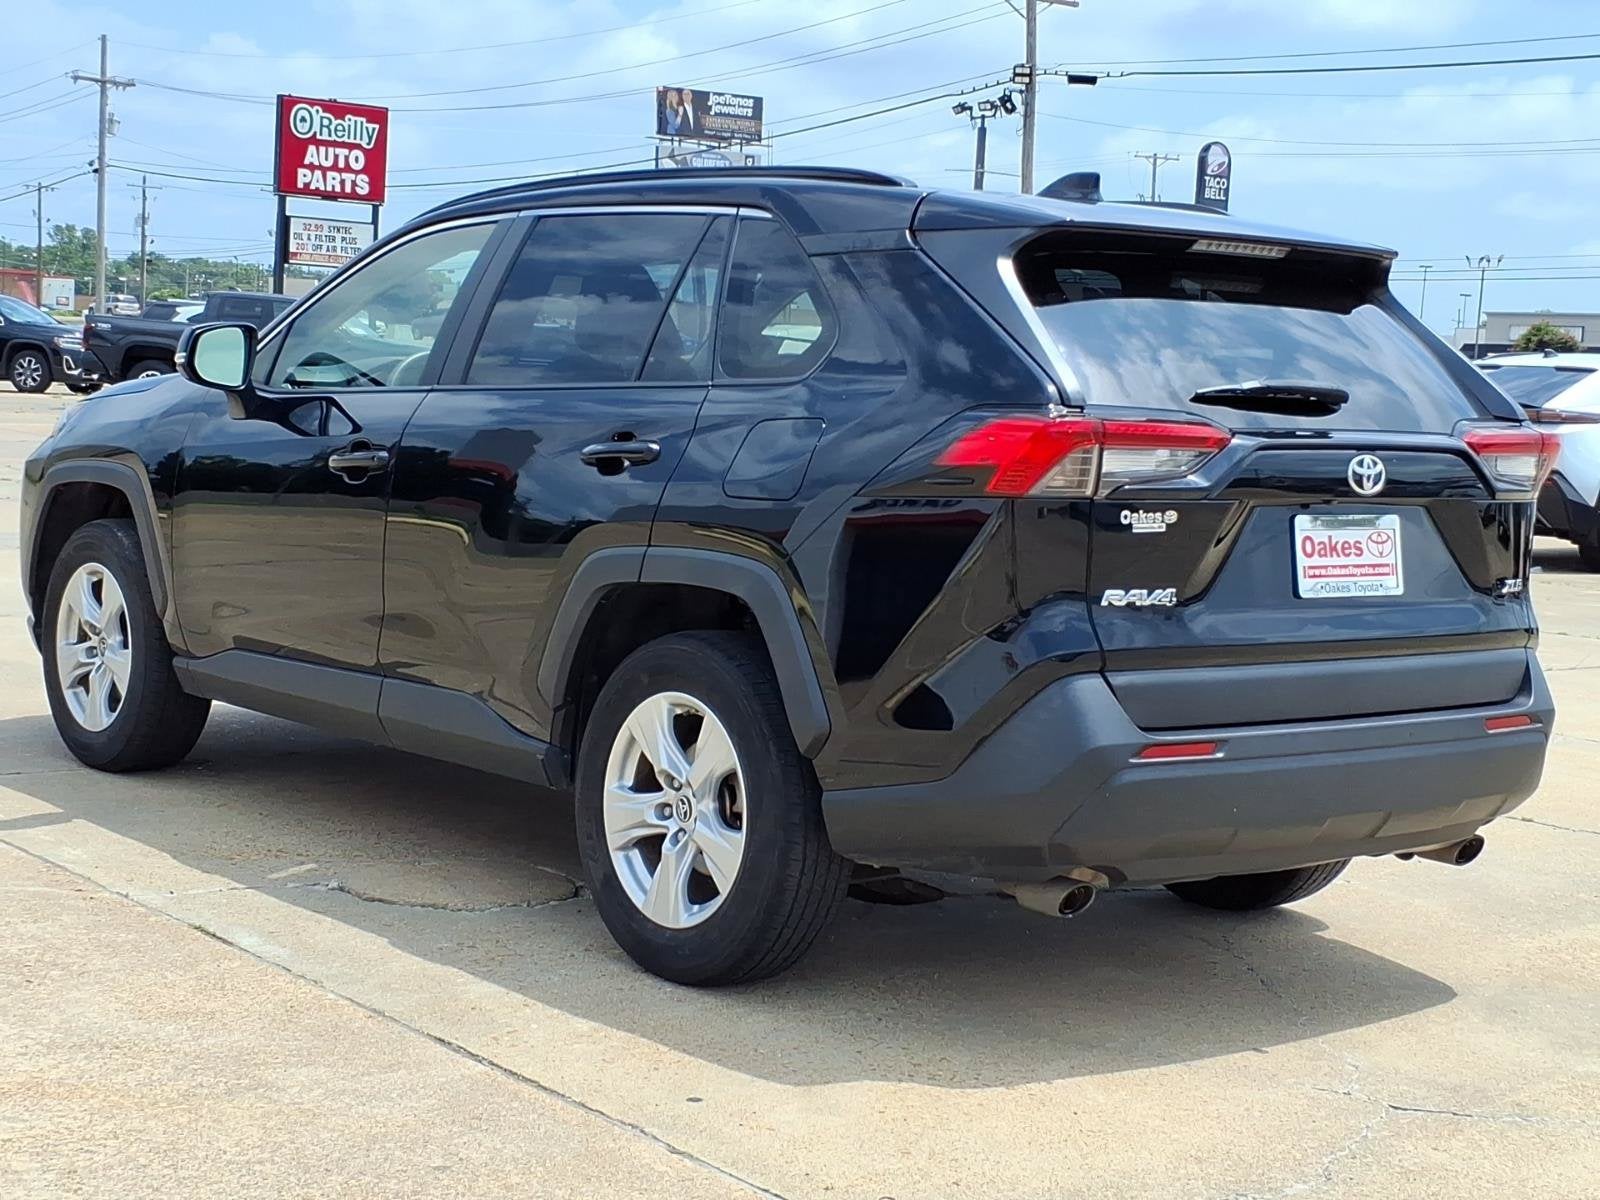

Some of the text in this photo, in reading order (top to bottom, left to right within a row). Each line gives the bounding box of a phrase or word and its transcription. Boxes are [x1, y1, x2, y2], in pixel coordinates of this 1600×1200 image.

[291, 105, 378, 148] O'Reilly
[304, 145, 365, 171] AUTO
[297, 168, 370, 195] PARTS
[1204, 176, 1227, 189] TACO
[1204, 187, 1226, 200] BELL
[303, 223, 352, 235] 32.99 SYNTEC
[293, 232, 358, 246] OIL & FILTER PLUS
[312, 243, 324, 252] OFF
[326, 245, 338, 254] AIR
[1120, 509, 1163, 525] Oakes
[1301, 535, 1364, 558] Oakes
[1309, 565, 1390, 577] www.OakesToyota.com
[1101, 588, 1177, 606] RAV4
